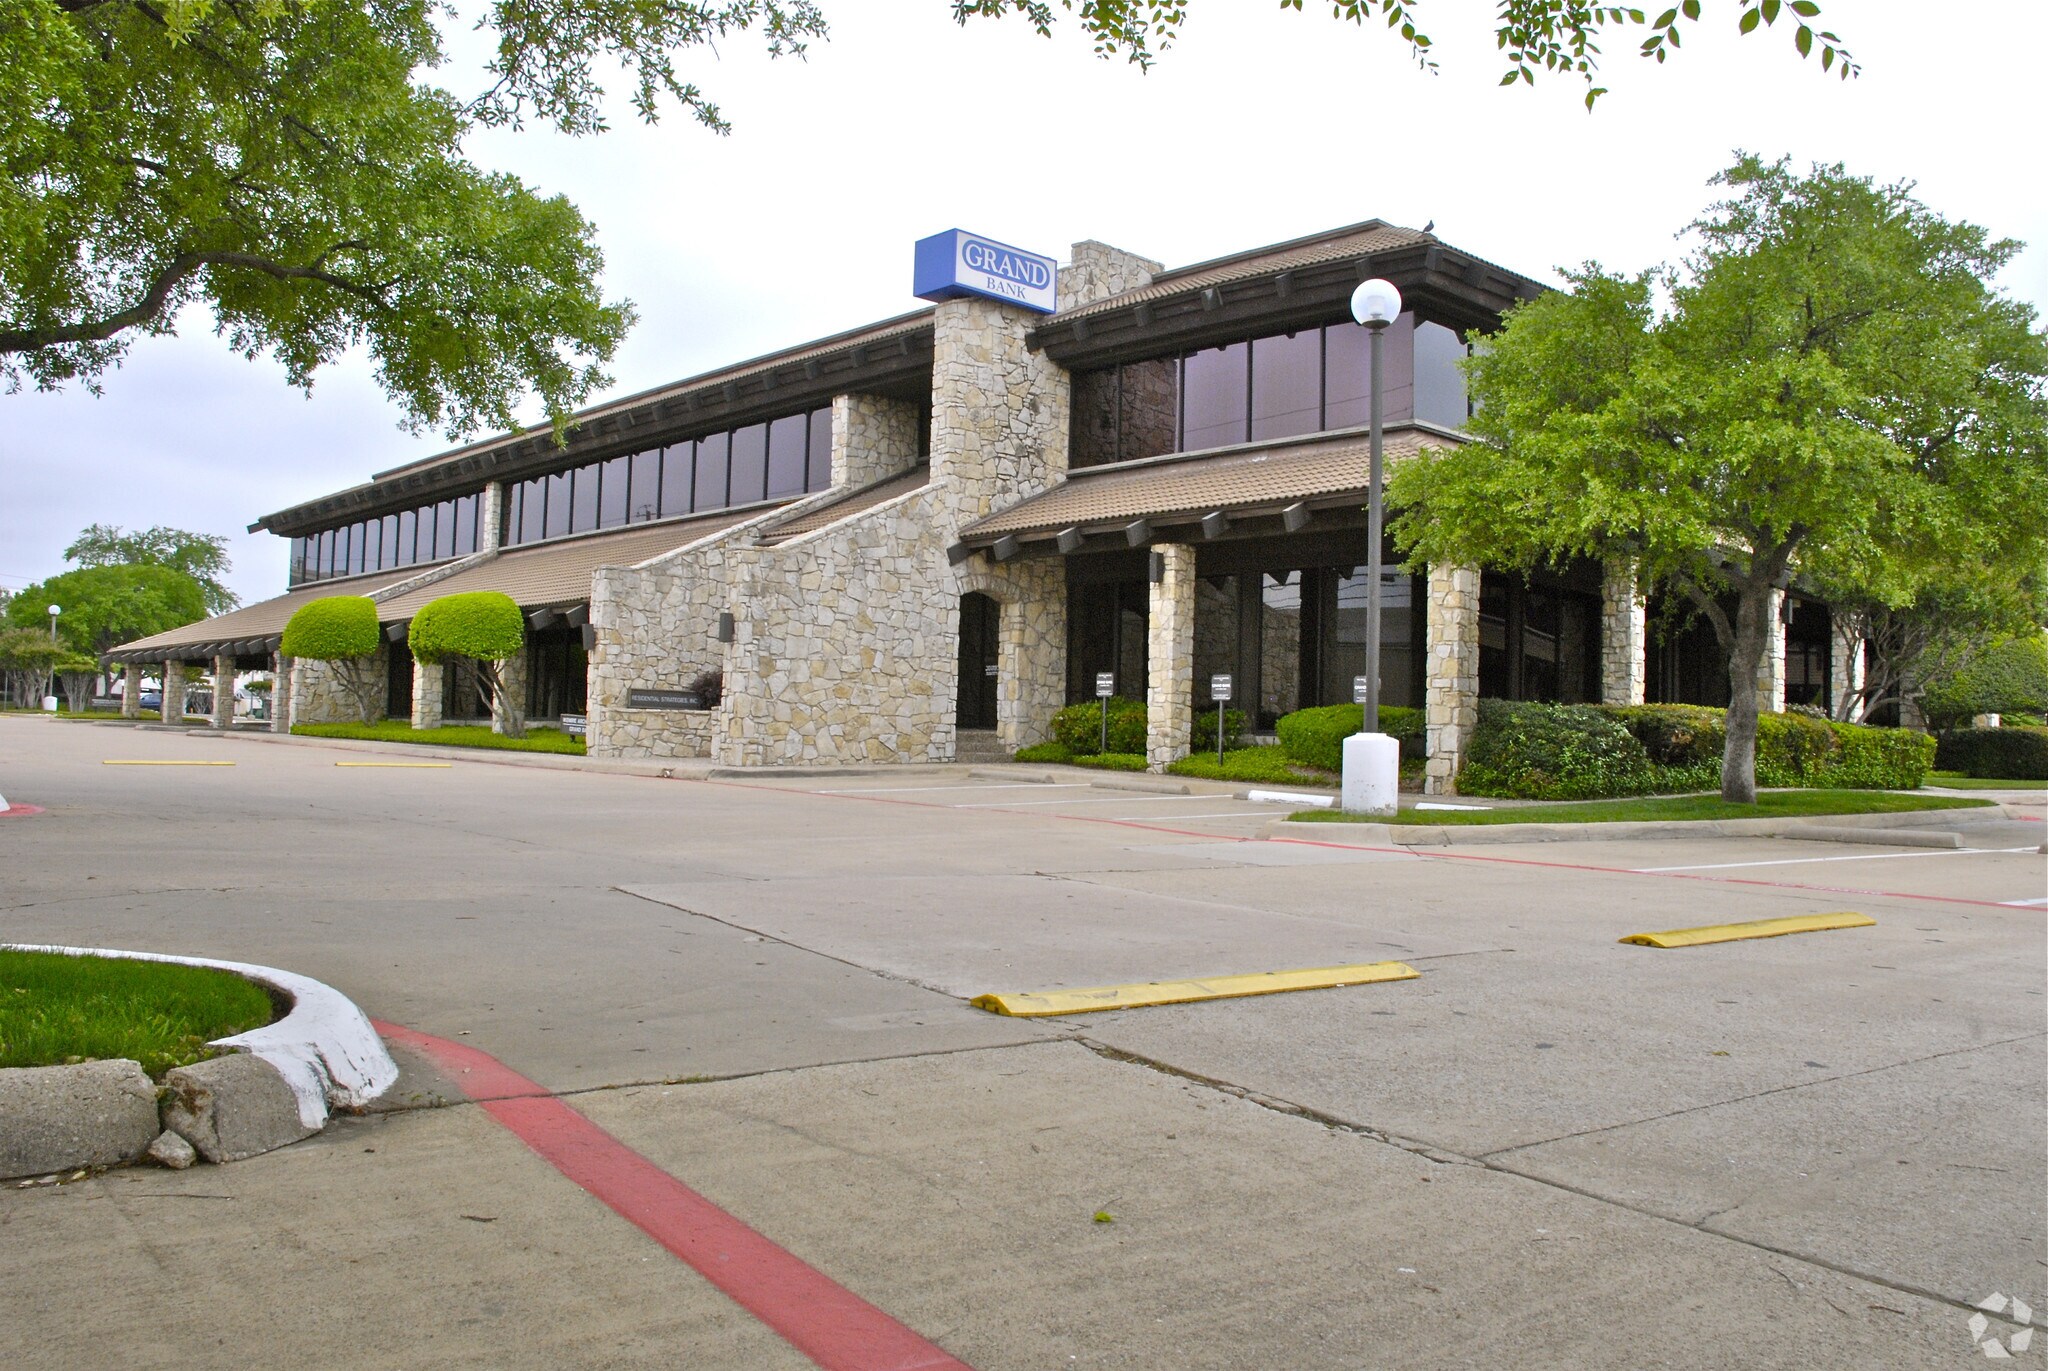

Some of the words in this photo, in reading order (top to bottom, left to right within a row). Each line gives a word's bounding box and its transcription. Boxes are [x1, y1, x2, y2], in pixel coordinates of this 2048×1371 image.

[965, 243, 1048, 286] GRAND
[986, 276, 1026, 299] BANK
[631, 694, 660, 703] RESIDENTIAL
